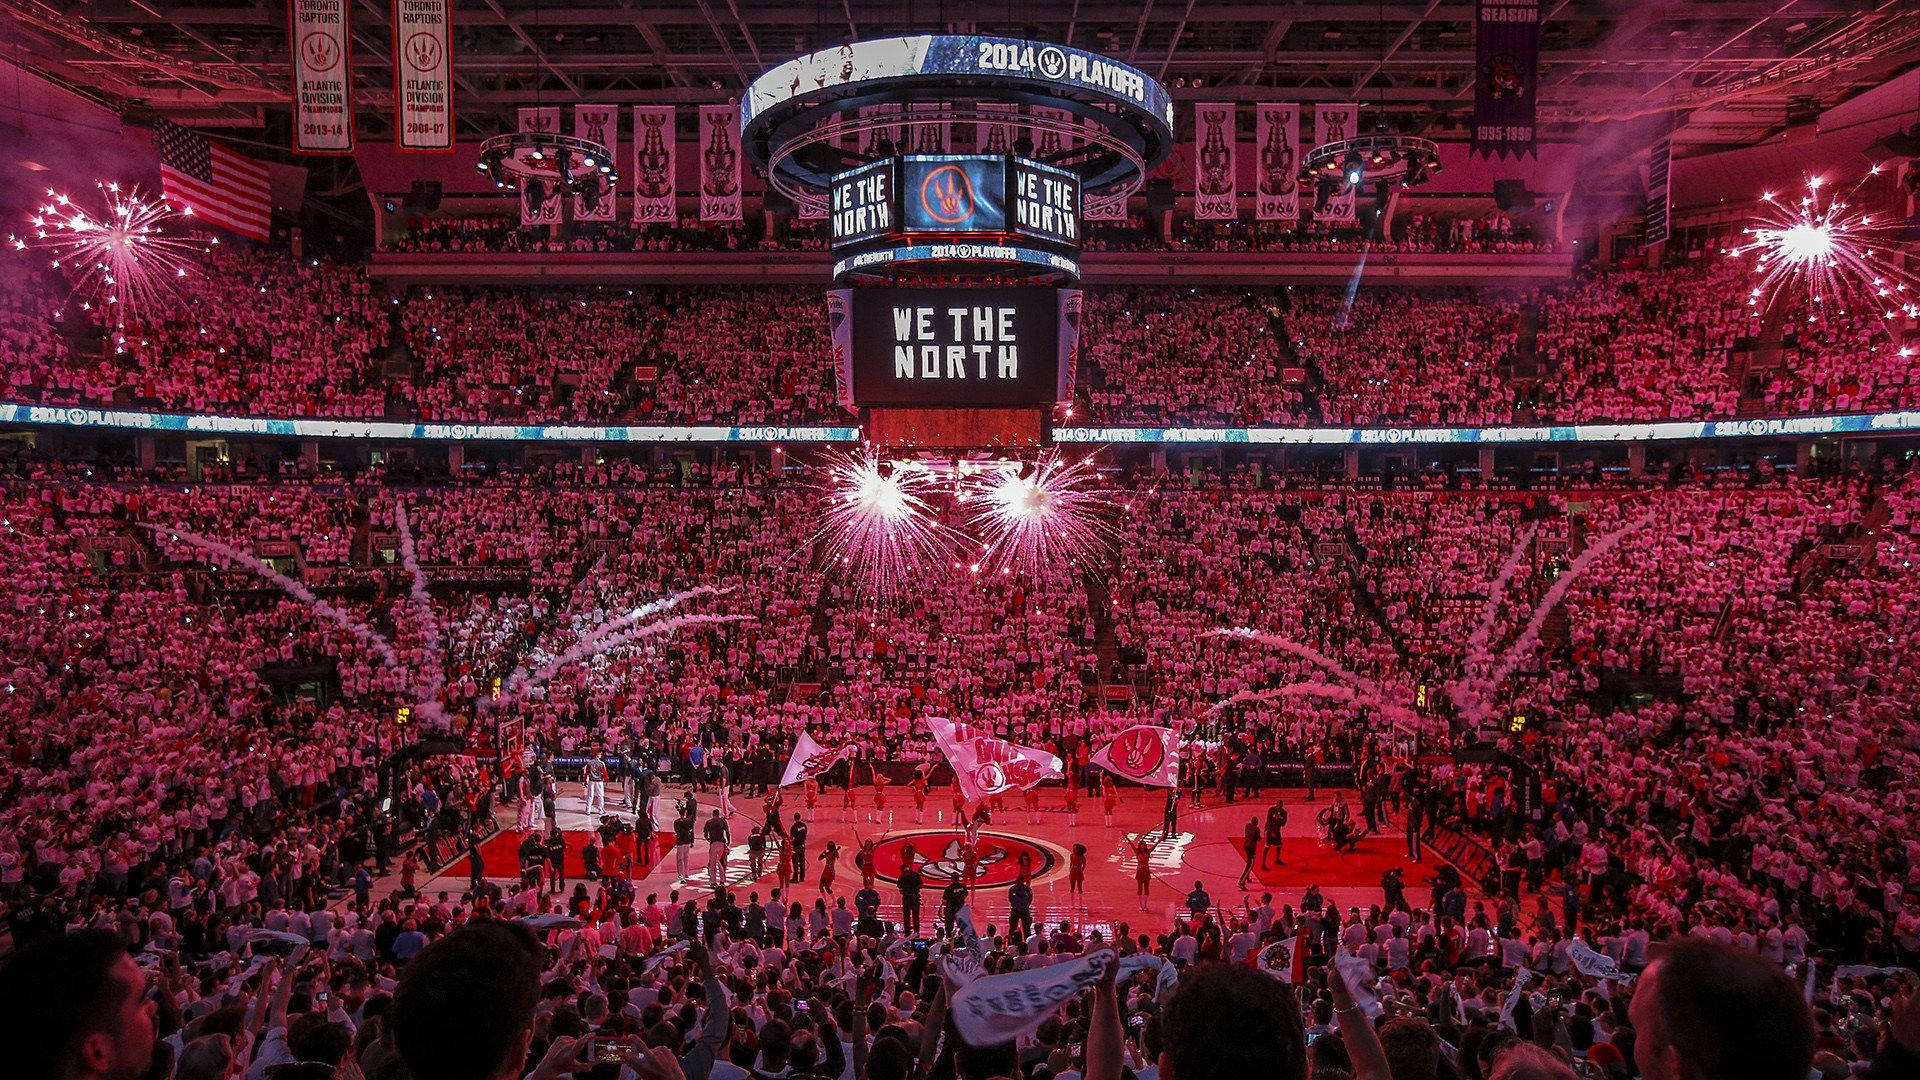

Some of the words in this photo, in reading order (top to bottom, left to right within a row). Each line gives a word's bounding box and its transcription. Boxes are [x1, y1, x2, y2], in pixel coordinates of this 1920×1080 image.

[300, 0, 340, 11] TORONTO
[403, 0, 442, 11] TORONTO
[300, 13, 340, 24] RAPTORS
[403, 13, 442, 24] RAPTORS
[1481, 7, 1538, 22] SEASON
[978, 42, 1036, 72] 2014
[1069, 53, 1144, 102] PLAYOFFS
[302, 81, 342, 92] ATLANTIC
[406, 80, 443, 91] ATLANTIC
[302, 93, 342, 104] DIVISION
[406, 92, 444, 103] DIVISION
[406, 104, 444, 113] CHAMPIONS
[303, 124, 343, 136] 2013-14
[407, 123, 444, 135] 2006-07
[833, 182, 852, 212] WE
[856, 174, 886, 203] THE
[1016, 170, 1038, 200] WE
[1042, 178, 1073, 211] THE
[1261, 202, 1294, 215] 1964
[1324, 203, 1350, 216] 967
[833, 203, 889, 238] NORTH
[1017, 199, 1075, 239] NORTH
[931, 245, 957, 259] 2014
[971, 246, 1017, 260] PLAYOFFS
[893, 308, 935, 342] WE
[948, 306, 1017, 342] THE
[894, 345, 1019, 379] NORTH
[30, 406, 68, 422] 2014
[88, 410, 152, 428] PLAYOFFS
[424, 425, 451, 439] 2014
[466, 425, 516, 439] PLAYOFFS
[1715, 421, 1749, 436] 2014
[1769, 417, 1834, 434] PLAYOFFS
[739, 427, 766, 441] 2014
[778, 427, 825, 441] PLAYOFFS
[1089, 429, 1136, 442] PLAYOFFS
[1361, 429, 1386, 442] 2014
[1402, 428, 1451, 442] PLAYOFFS
